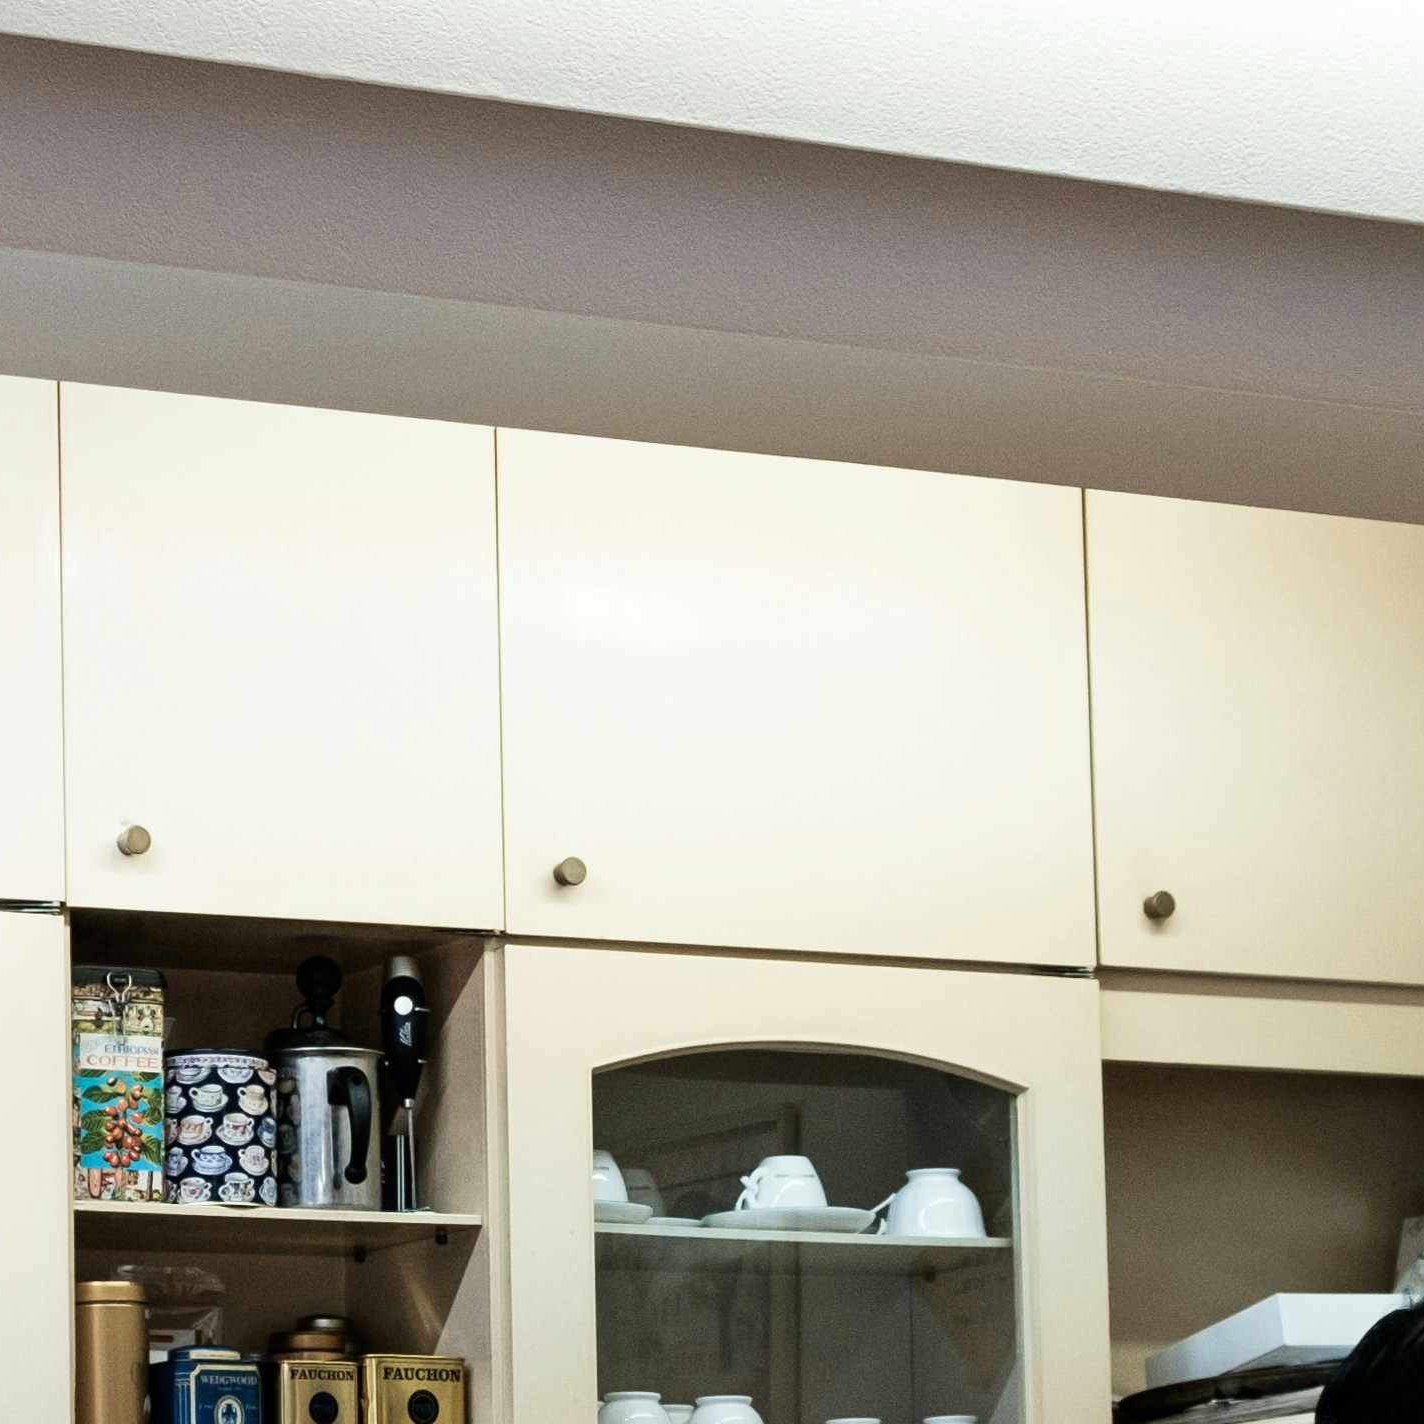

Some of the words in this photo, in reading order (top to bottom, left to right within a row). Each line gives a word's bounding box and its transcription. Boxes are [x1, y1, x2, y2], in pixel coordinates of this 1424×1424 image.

[86, 1054, 159, 1069] COFFEE
[200, 1375, 258, 1385] WEDGWOOD
[290, 1369, 354, 1381] FAUCHON
[383, 1367, 461, 1382] FAUCHON
